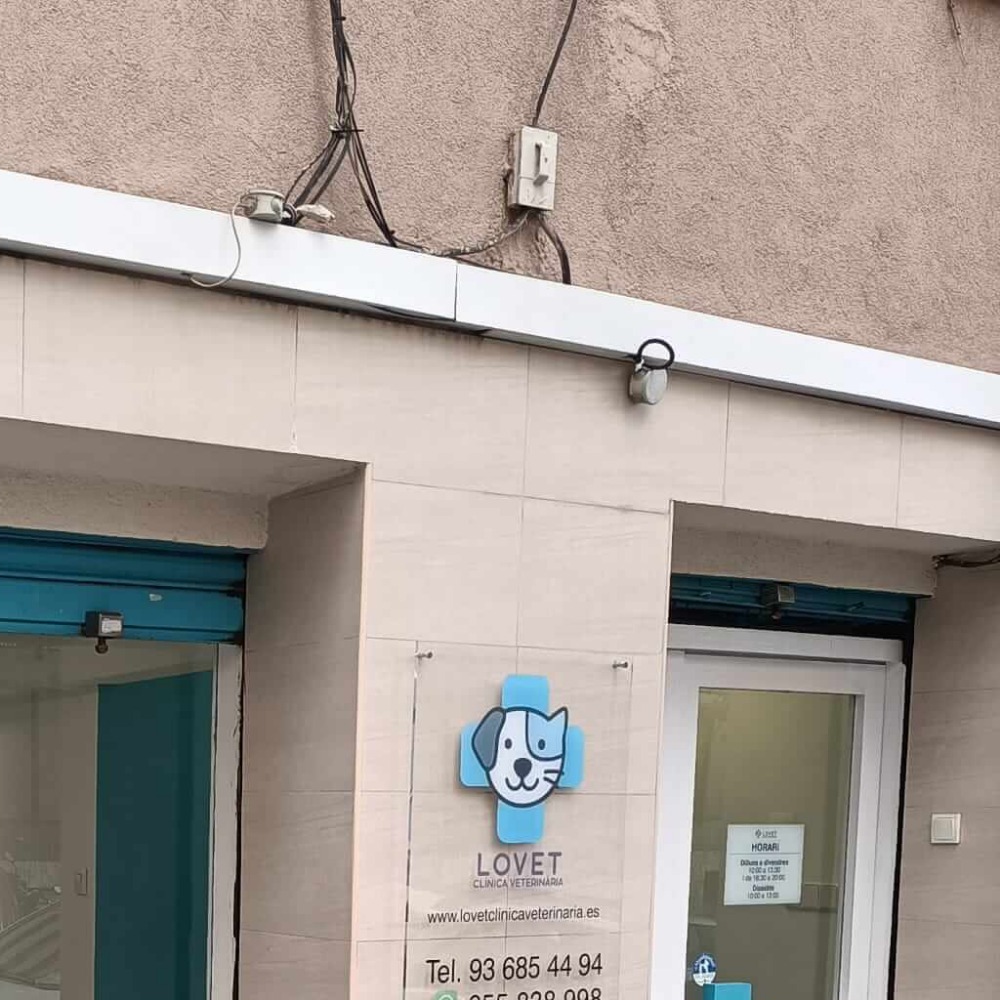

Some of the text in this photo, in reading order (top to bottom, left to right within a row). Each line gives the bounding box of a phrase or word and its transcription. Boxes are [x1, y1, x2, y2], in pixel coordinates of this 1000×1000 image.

[751, 842, 780, 852] HORARI
[477, 851, 562, 876] LOVET
[427, 906, 601, 924] www.lovetclinicaveterinaria.es
[425, 953, 603, 984] Tel. 93 685 44 94
